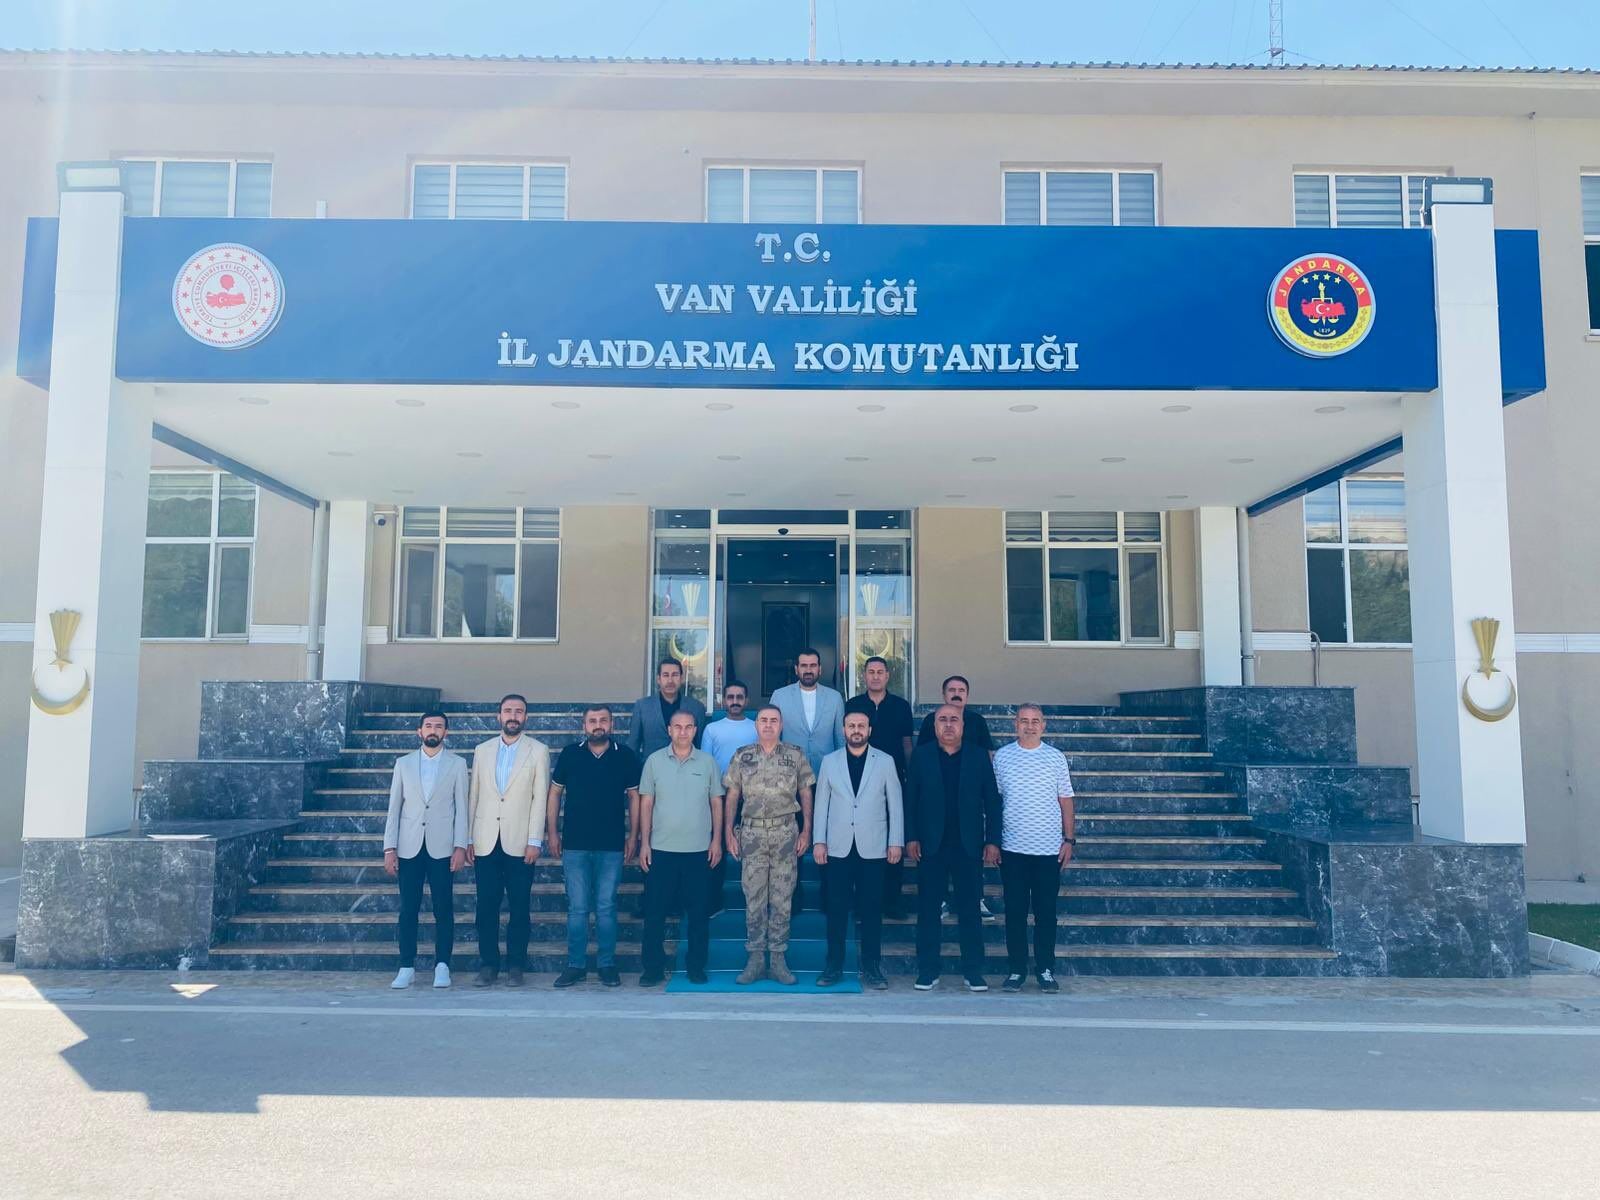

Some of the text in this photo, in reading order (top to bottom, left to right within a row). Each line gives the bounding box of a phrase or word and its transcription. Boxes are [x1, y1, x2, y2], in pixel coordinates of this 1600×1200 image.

[755, 232, 831, 263] T.C.
[1278, 259, 1367, 297] JANDARMA
[655, 279, 918, 315] VAN VALİLİĞİ
[497, 331, 1079, 374] İL JANDARMA KOMUTANLIĞI
